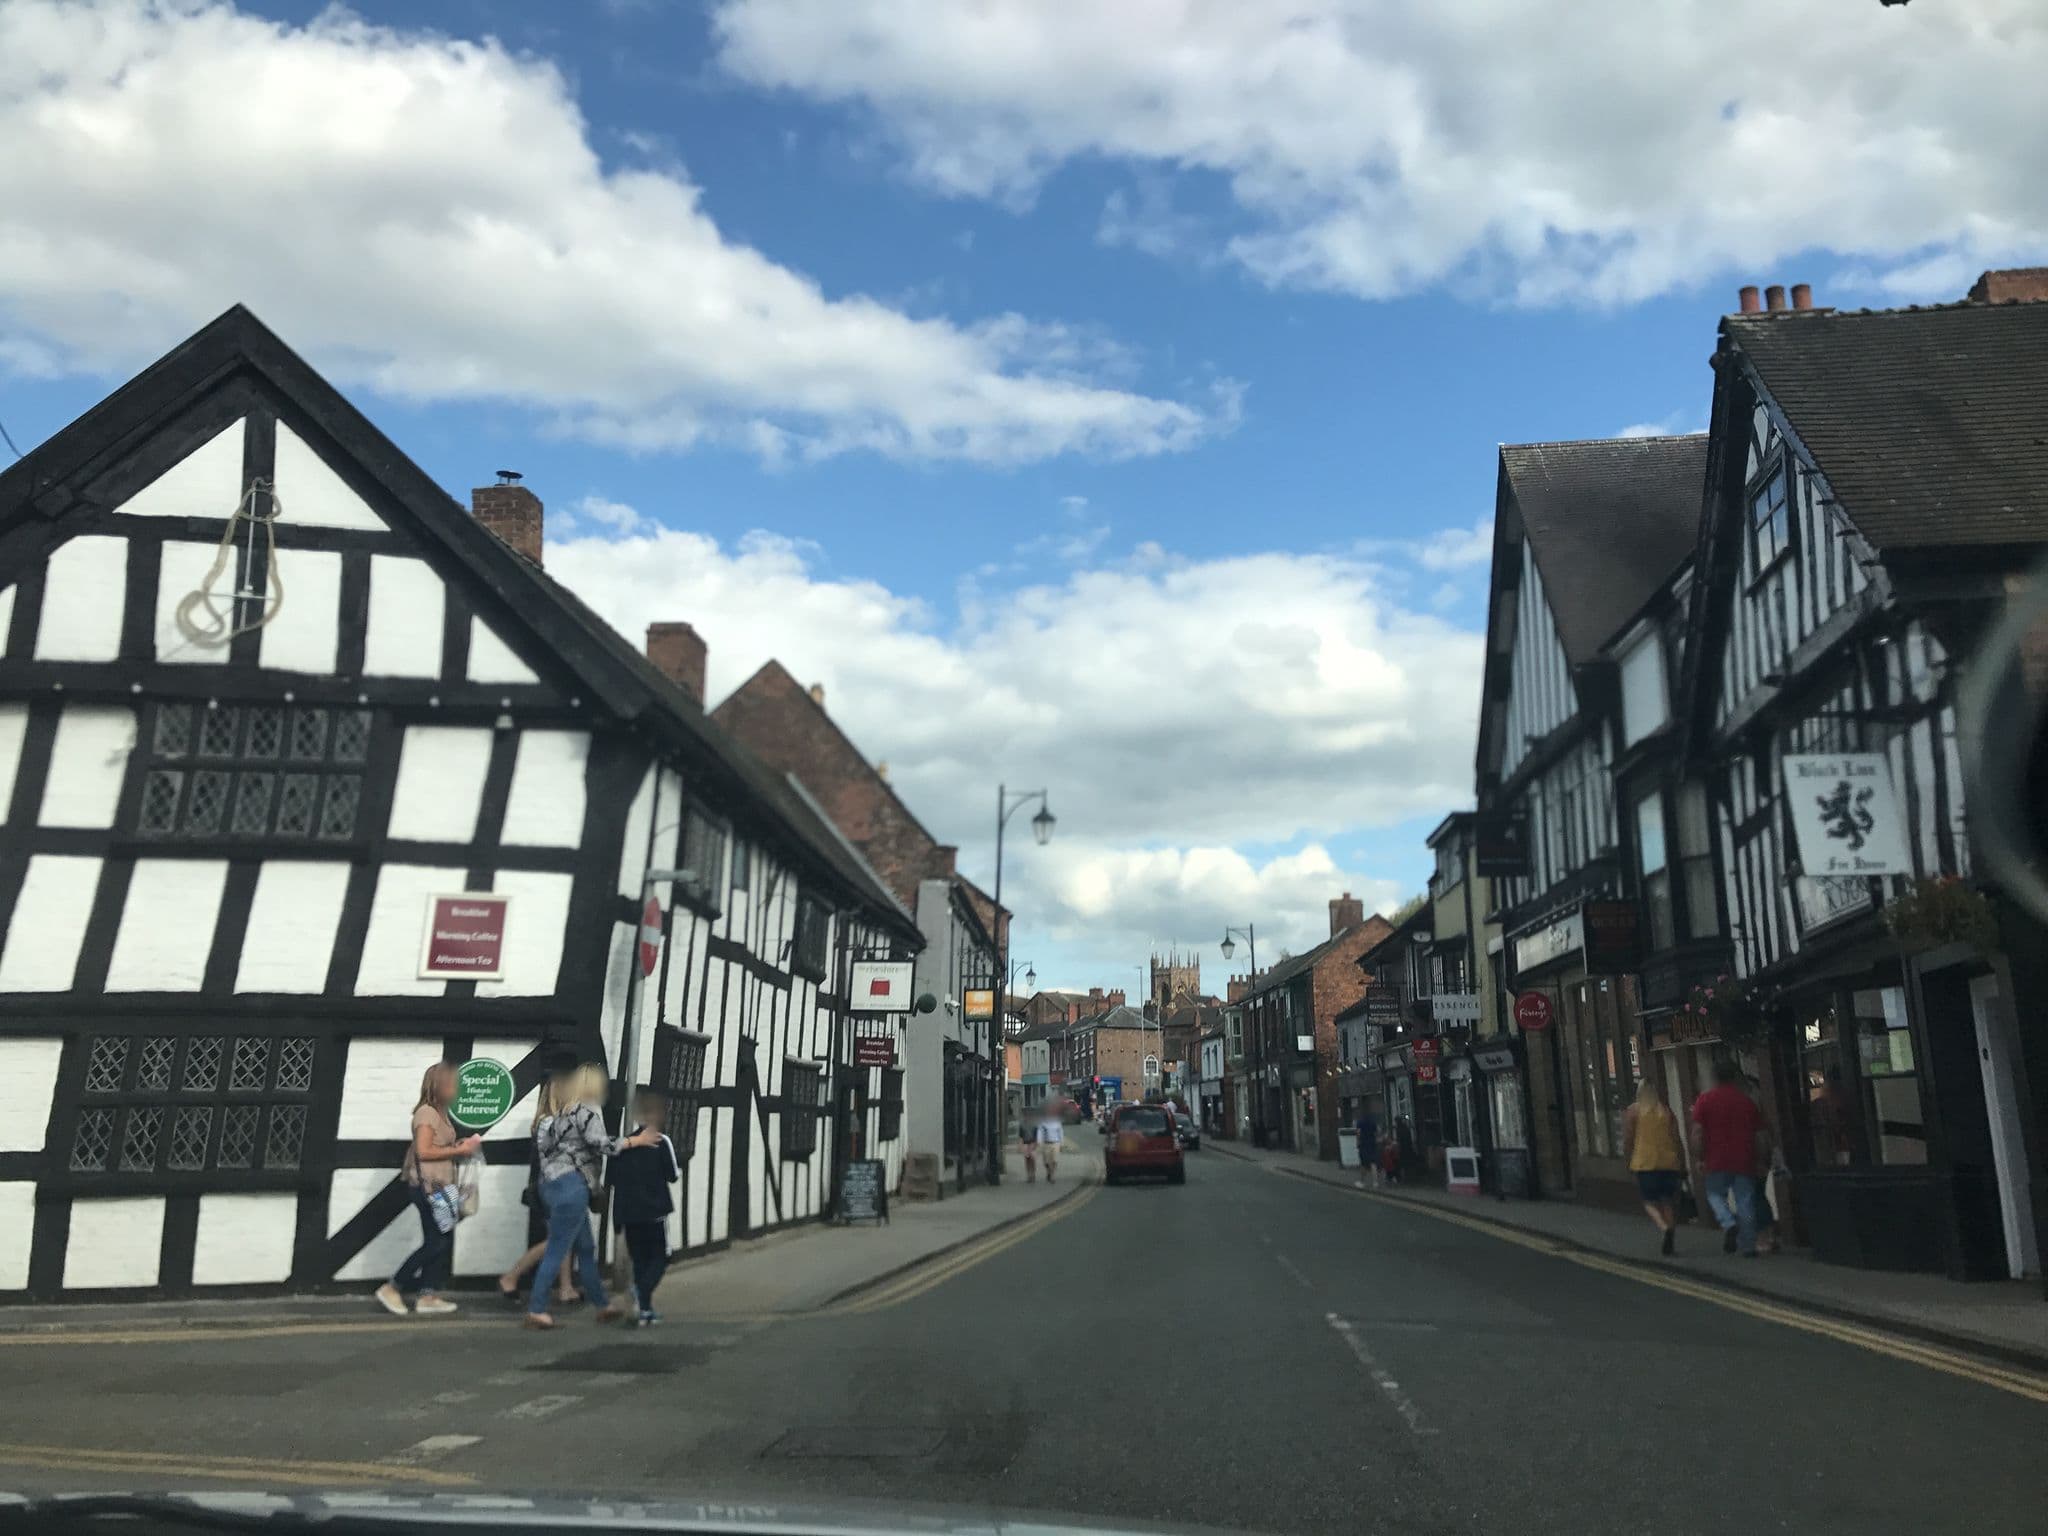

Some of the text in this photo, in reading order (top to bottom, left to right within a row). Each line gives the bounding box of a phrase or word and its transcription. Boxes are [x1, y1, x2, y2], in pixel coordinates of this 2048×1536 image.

[435, 955, 494, 966] Afternoon Tea
[462, 1074, 500, 1087] Special
[457, 1103, 499, 1114] Interest
